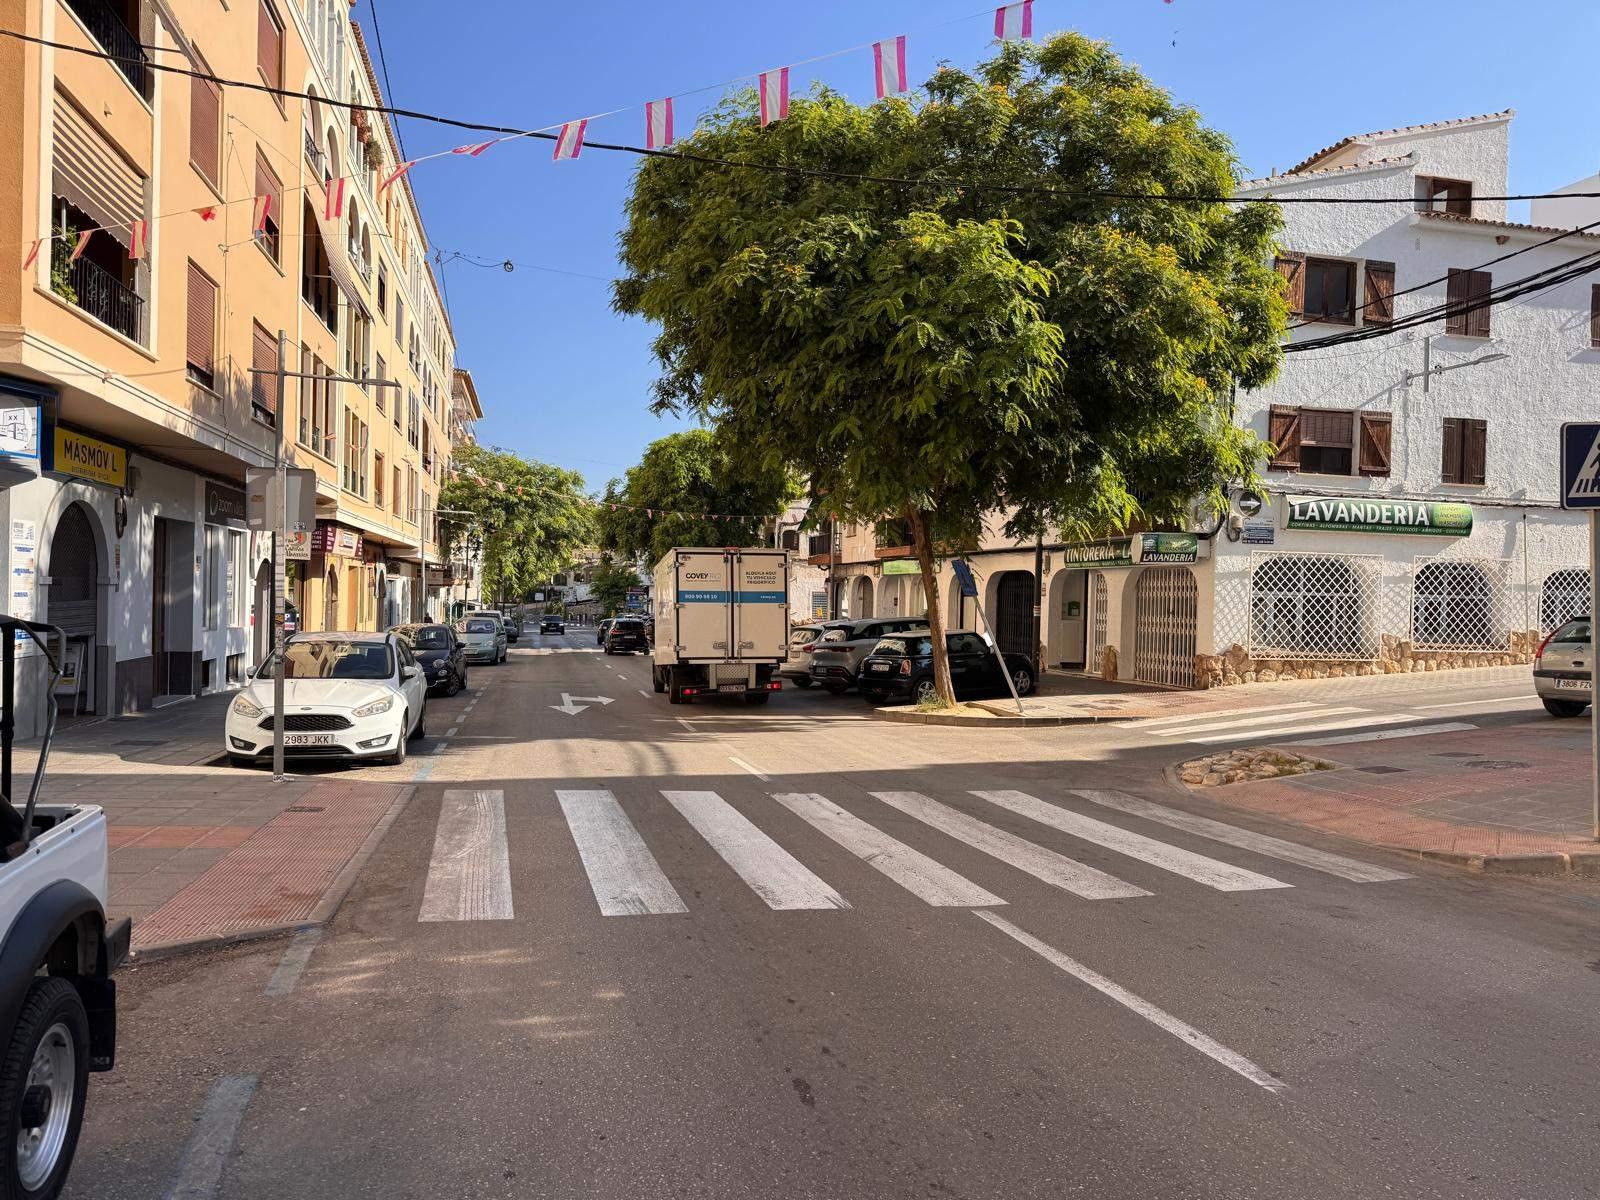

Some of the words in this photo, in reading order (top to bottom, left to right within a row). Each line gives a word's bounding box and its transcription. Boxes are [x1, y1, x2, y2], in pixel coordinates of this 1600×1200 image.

[1143, 553, 1194, 562] LAVANDERIA
[284, 735, 309, 745] 2983
[311, 735, 330, 745] JKK
